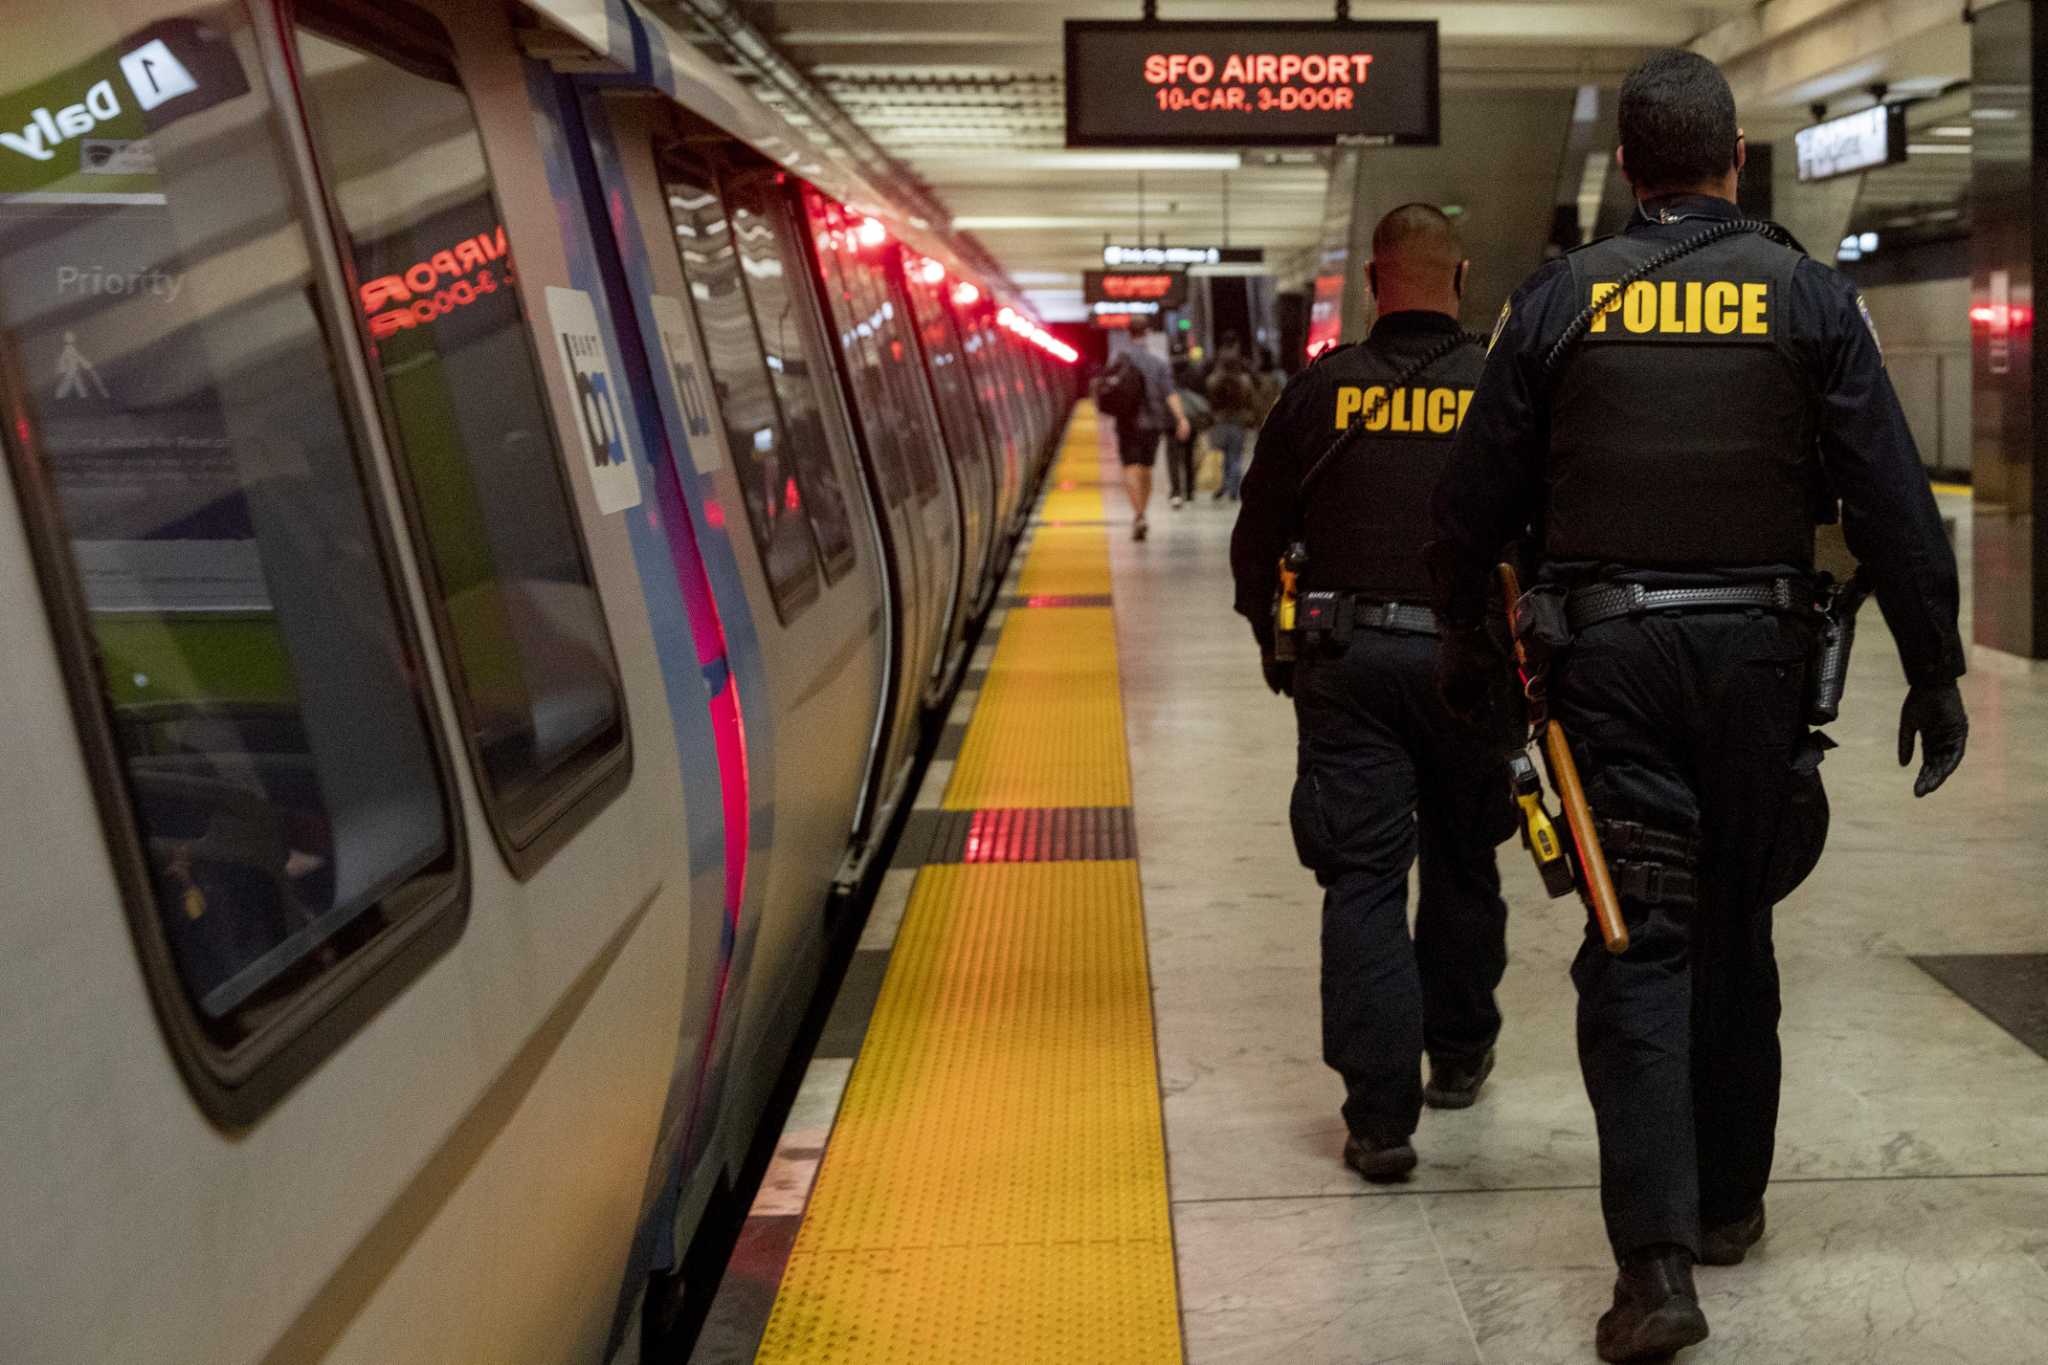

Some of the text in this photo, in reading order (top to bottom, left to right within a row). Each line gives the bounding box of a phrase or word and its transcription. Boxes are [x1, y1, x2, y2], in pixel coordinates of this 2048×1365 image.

[1144, 54, 1373, 84] SFO AIRPORT
[1256, 87, 1354, 112] 3-DOOR
[57, 265, 187, 303] Priority
[1590, 280, 1768, 334] POLICE
